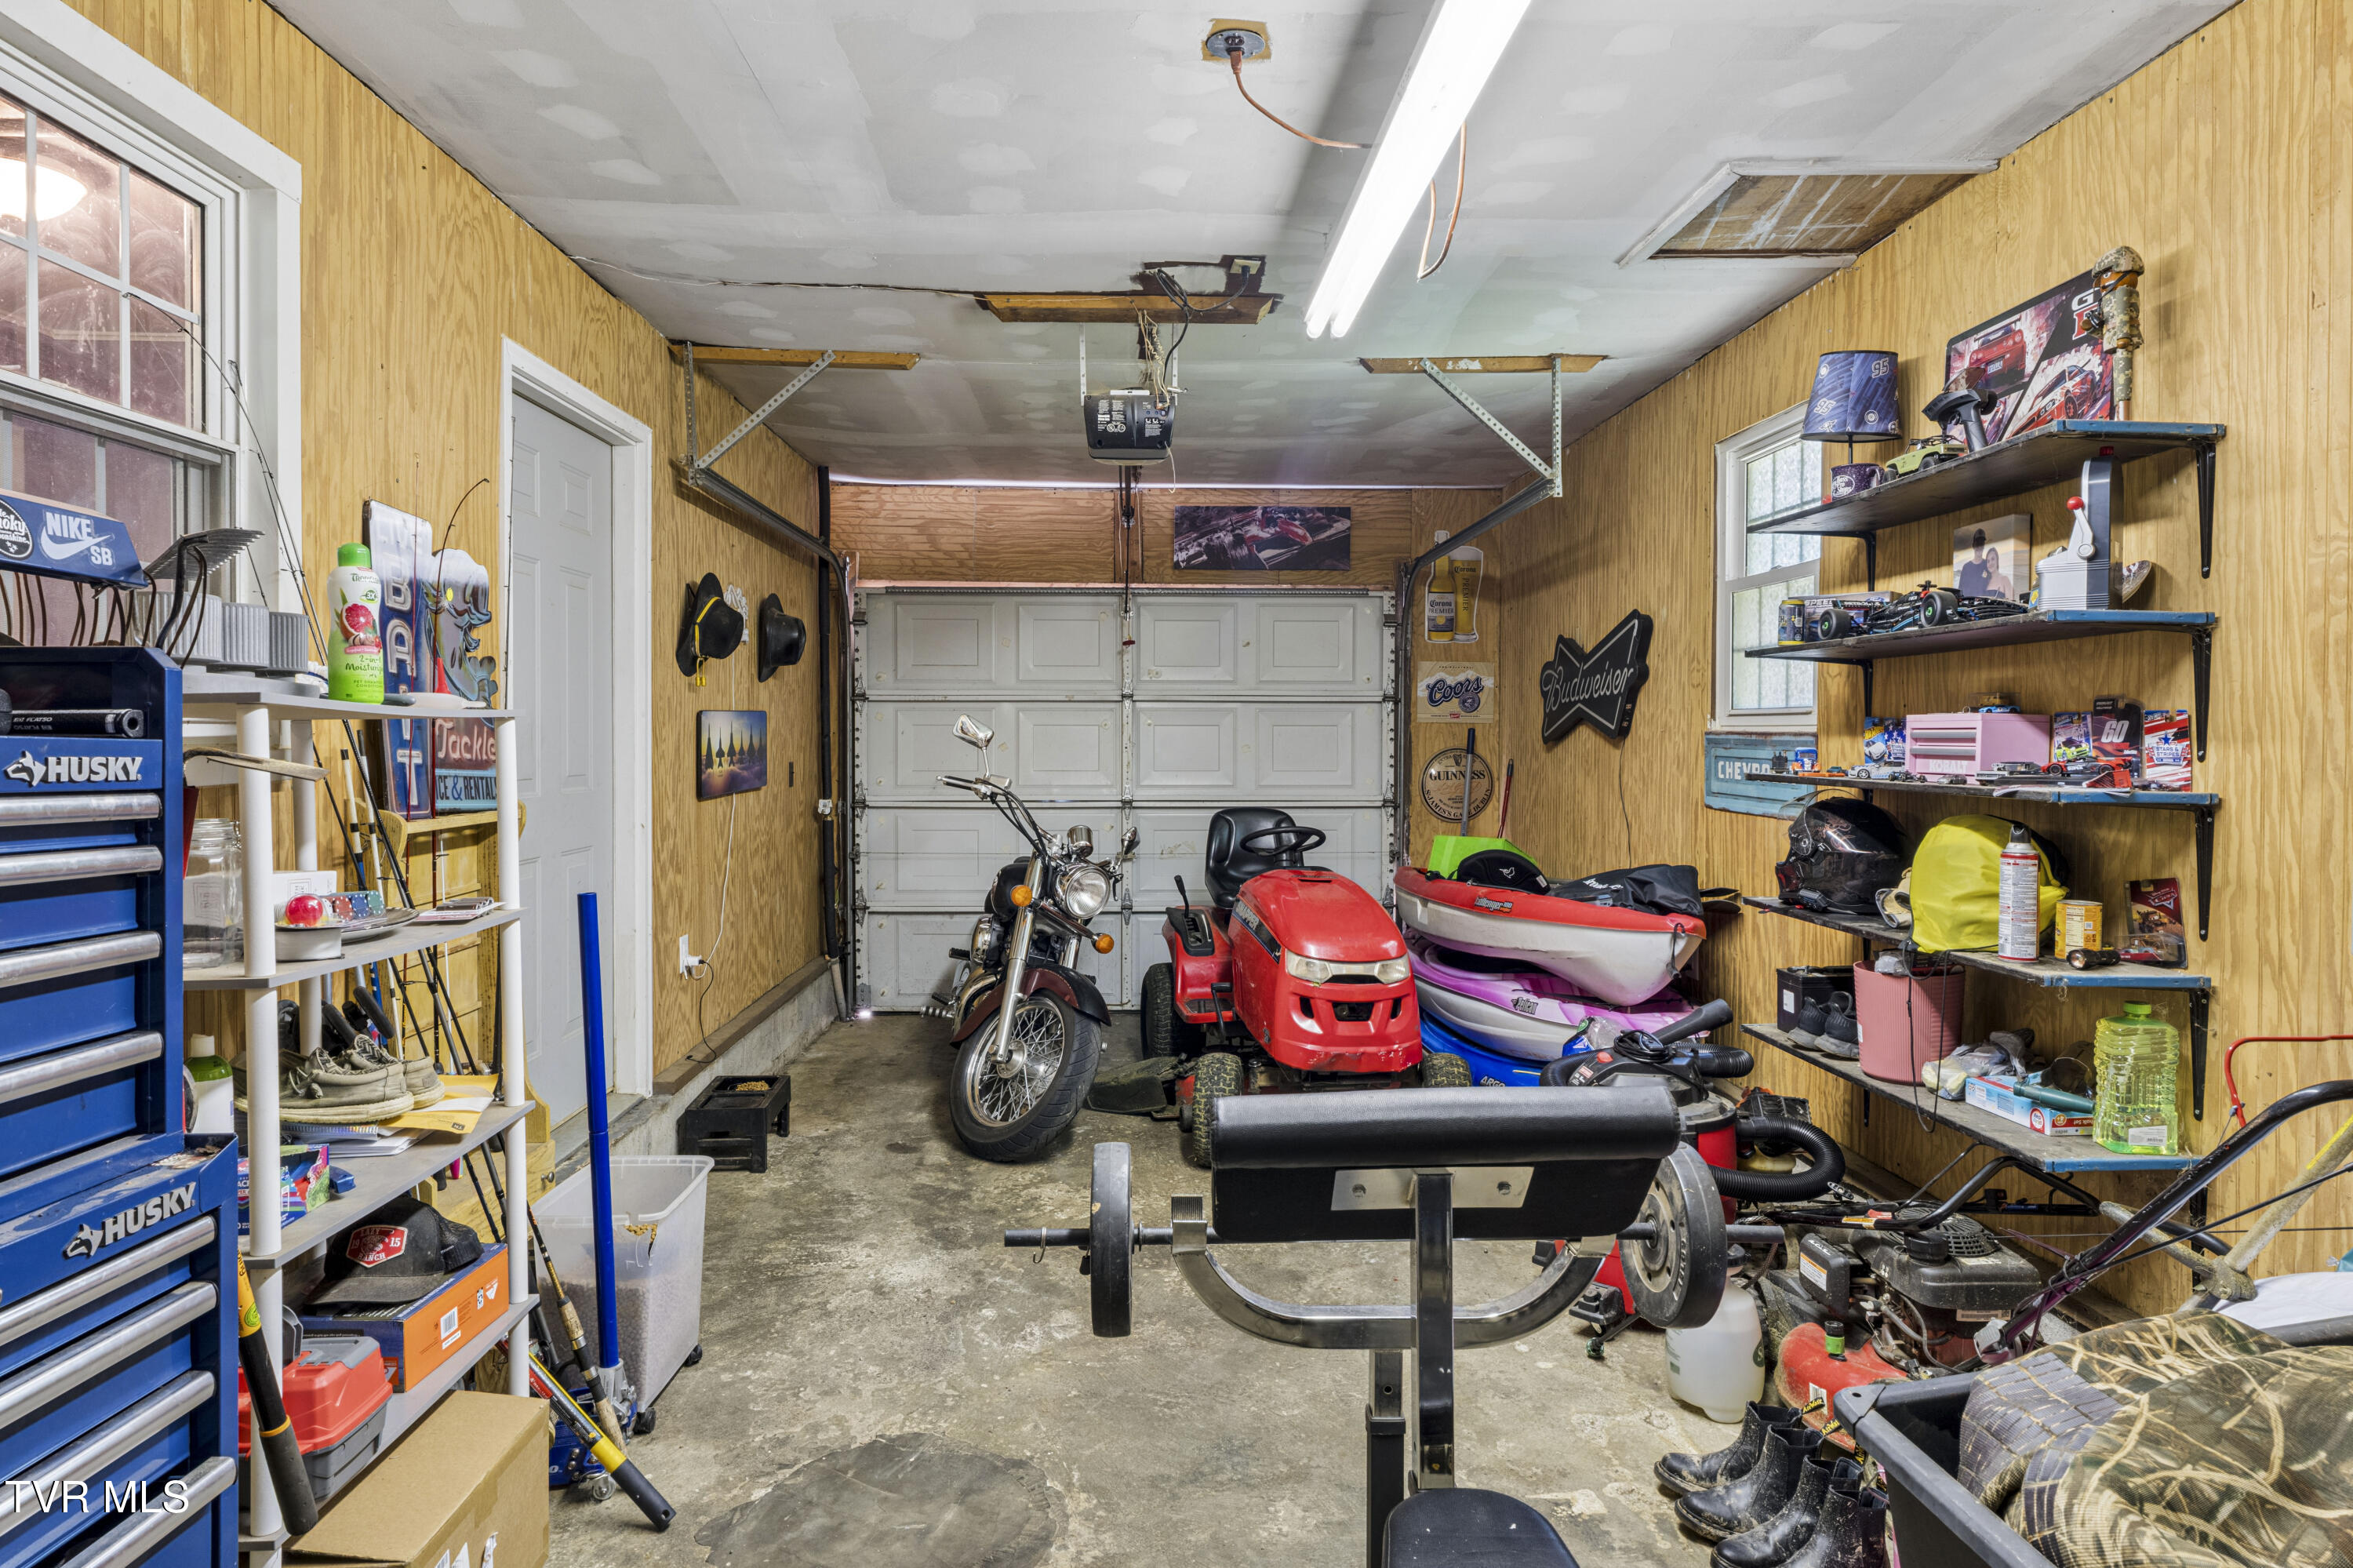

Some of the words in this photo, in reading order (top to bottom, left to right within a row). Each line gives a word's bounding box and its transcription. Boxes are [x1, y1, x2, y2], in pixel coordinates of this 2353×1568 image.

[1871, 358, 1889, 378] 95
[1813, 398, 1836, 415] 95
[45, 511, 93, 540] NIKE
[90, 545, 113, 566] SB
[366, 591, 376, 601] 3X
[1430, 599, 1453, 608] Corona
[1426, 675, 1484, 707] Coors
[1542, 661, 1634, 713] Budweiser
[436, 719, 496, 761] Tackle
[2100, 720, 2129, 744] 60
[47, 756, 143, 783] HUSKY
[1429, 769, 1486, 781] GUINNSS
[1717, 761, 1780, 780] CHEVRO
[1929, 759, 1969, 774] KOBALT
[451, 775, 463, 801] &
[1473, 788, 1491, 812] DUBLIN
[1515, 996, 1539, 1015] Pelican
[102, 1181, 196, 1246] HUSKY
[389, 1237, 402, 1248] 15
[358, 1253, 386, 1262] RANCH
